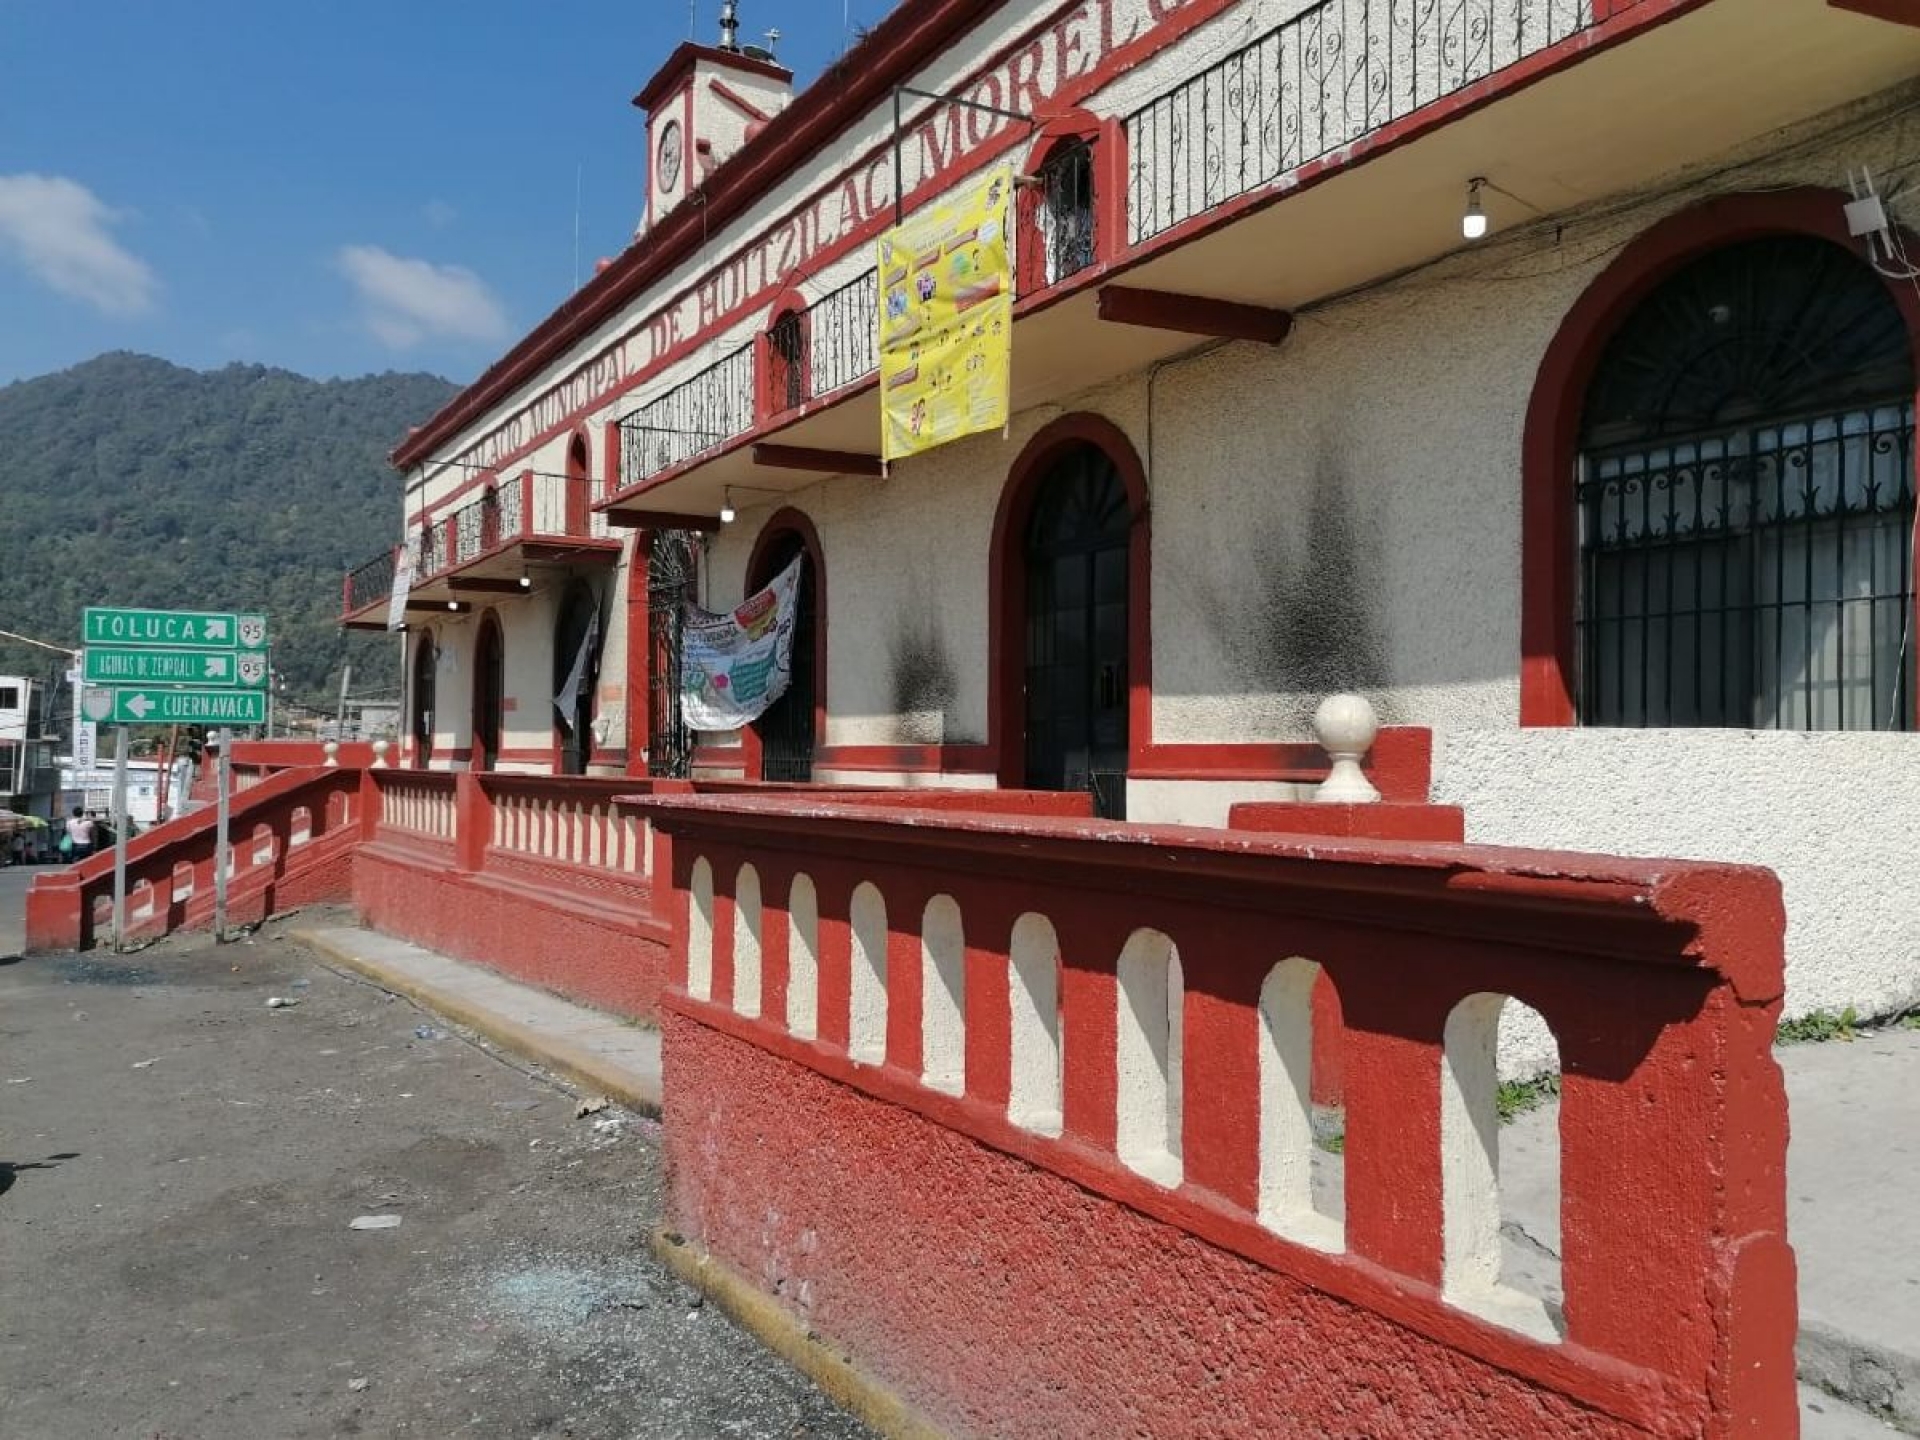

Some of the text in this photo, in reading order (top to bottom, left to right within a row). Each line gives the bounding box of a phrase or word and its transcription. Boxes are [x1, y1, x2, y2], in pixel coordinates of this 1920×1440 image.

[528, 345, 636, 440] MUNICIPAL
[650, 305, 684, 358] DE
[697, 157, 888, 329] HUITZILAC
[917, 0, 1190, 184] MOREL
[95, 615, 195, 639] TOLUCA
[241, 624, 261, 639] 95
[242, 661, 261, 677] 95
[163, 695, 254, 718] CUERNAVACA
